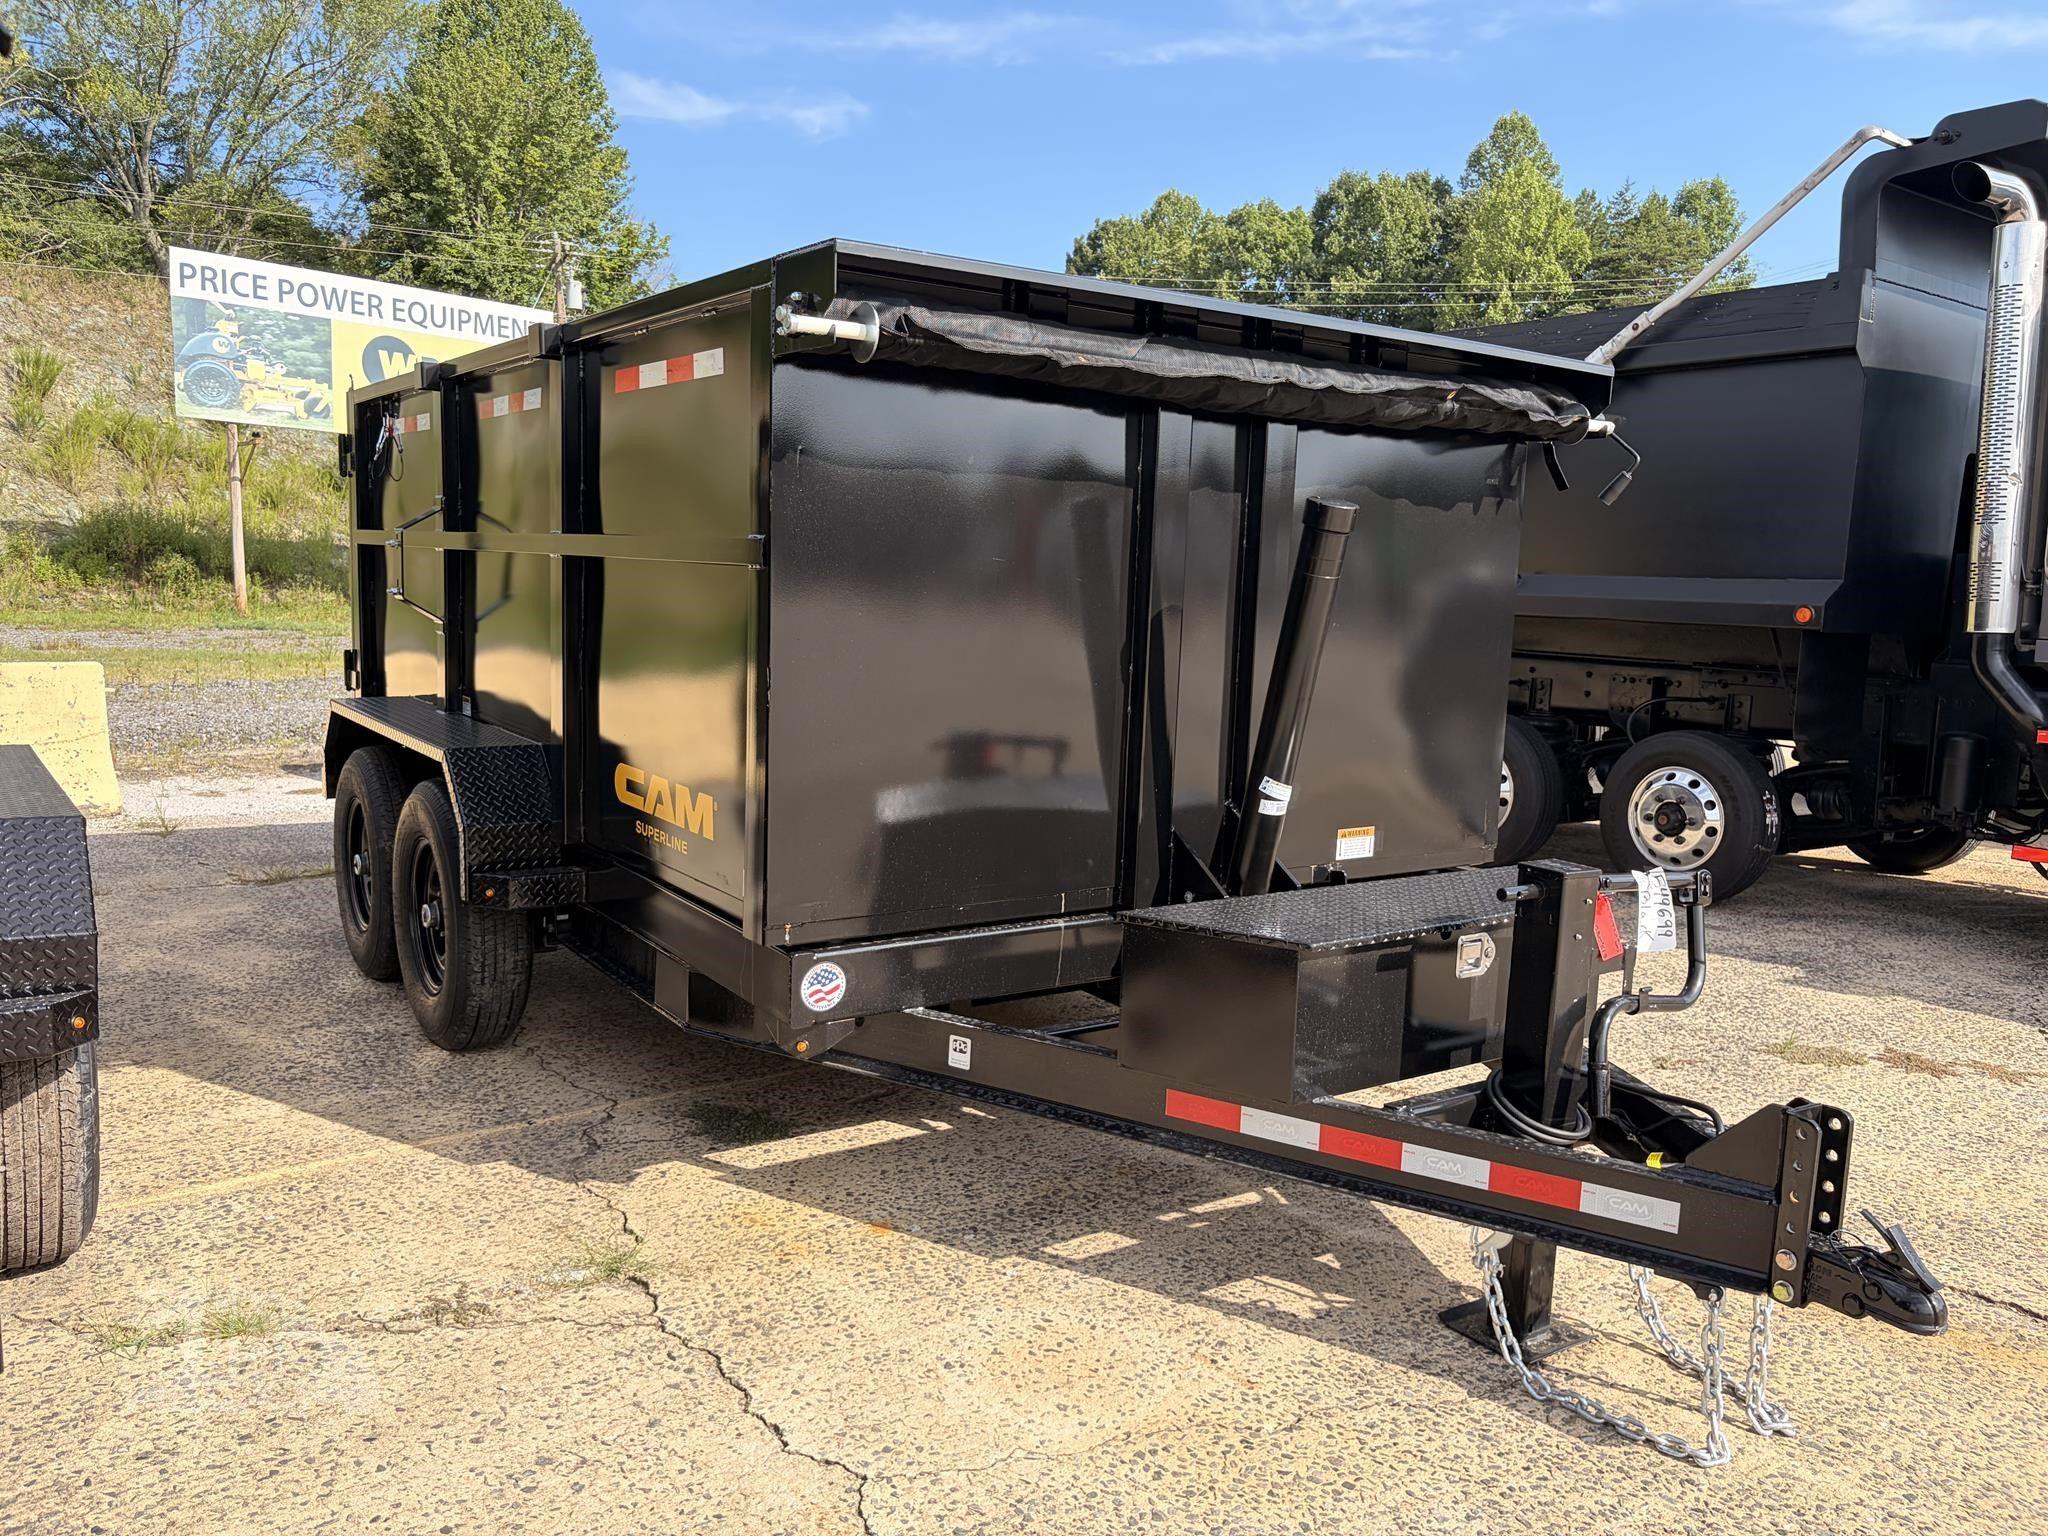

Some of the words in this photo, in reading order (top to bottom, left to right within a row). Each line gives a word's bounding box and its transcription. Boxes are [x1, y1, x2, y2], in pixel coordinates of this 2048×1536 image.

[179, 262, 268, 301] PRICE
[278, 278, 383, 319] POWER
[392, 297, 536, 340] EQUIPMEN
[614, 762, 713, 841] CAM
[635, 820, 688, 854] SUPERLINE
[1262, 1119, 1295, 1135] CAM
[1427, 1156, 1463, 1174] CAM
[1515, 1175, 1550, 1192] CAM
[1608, 1198, 1651, 1216] CAM
